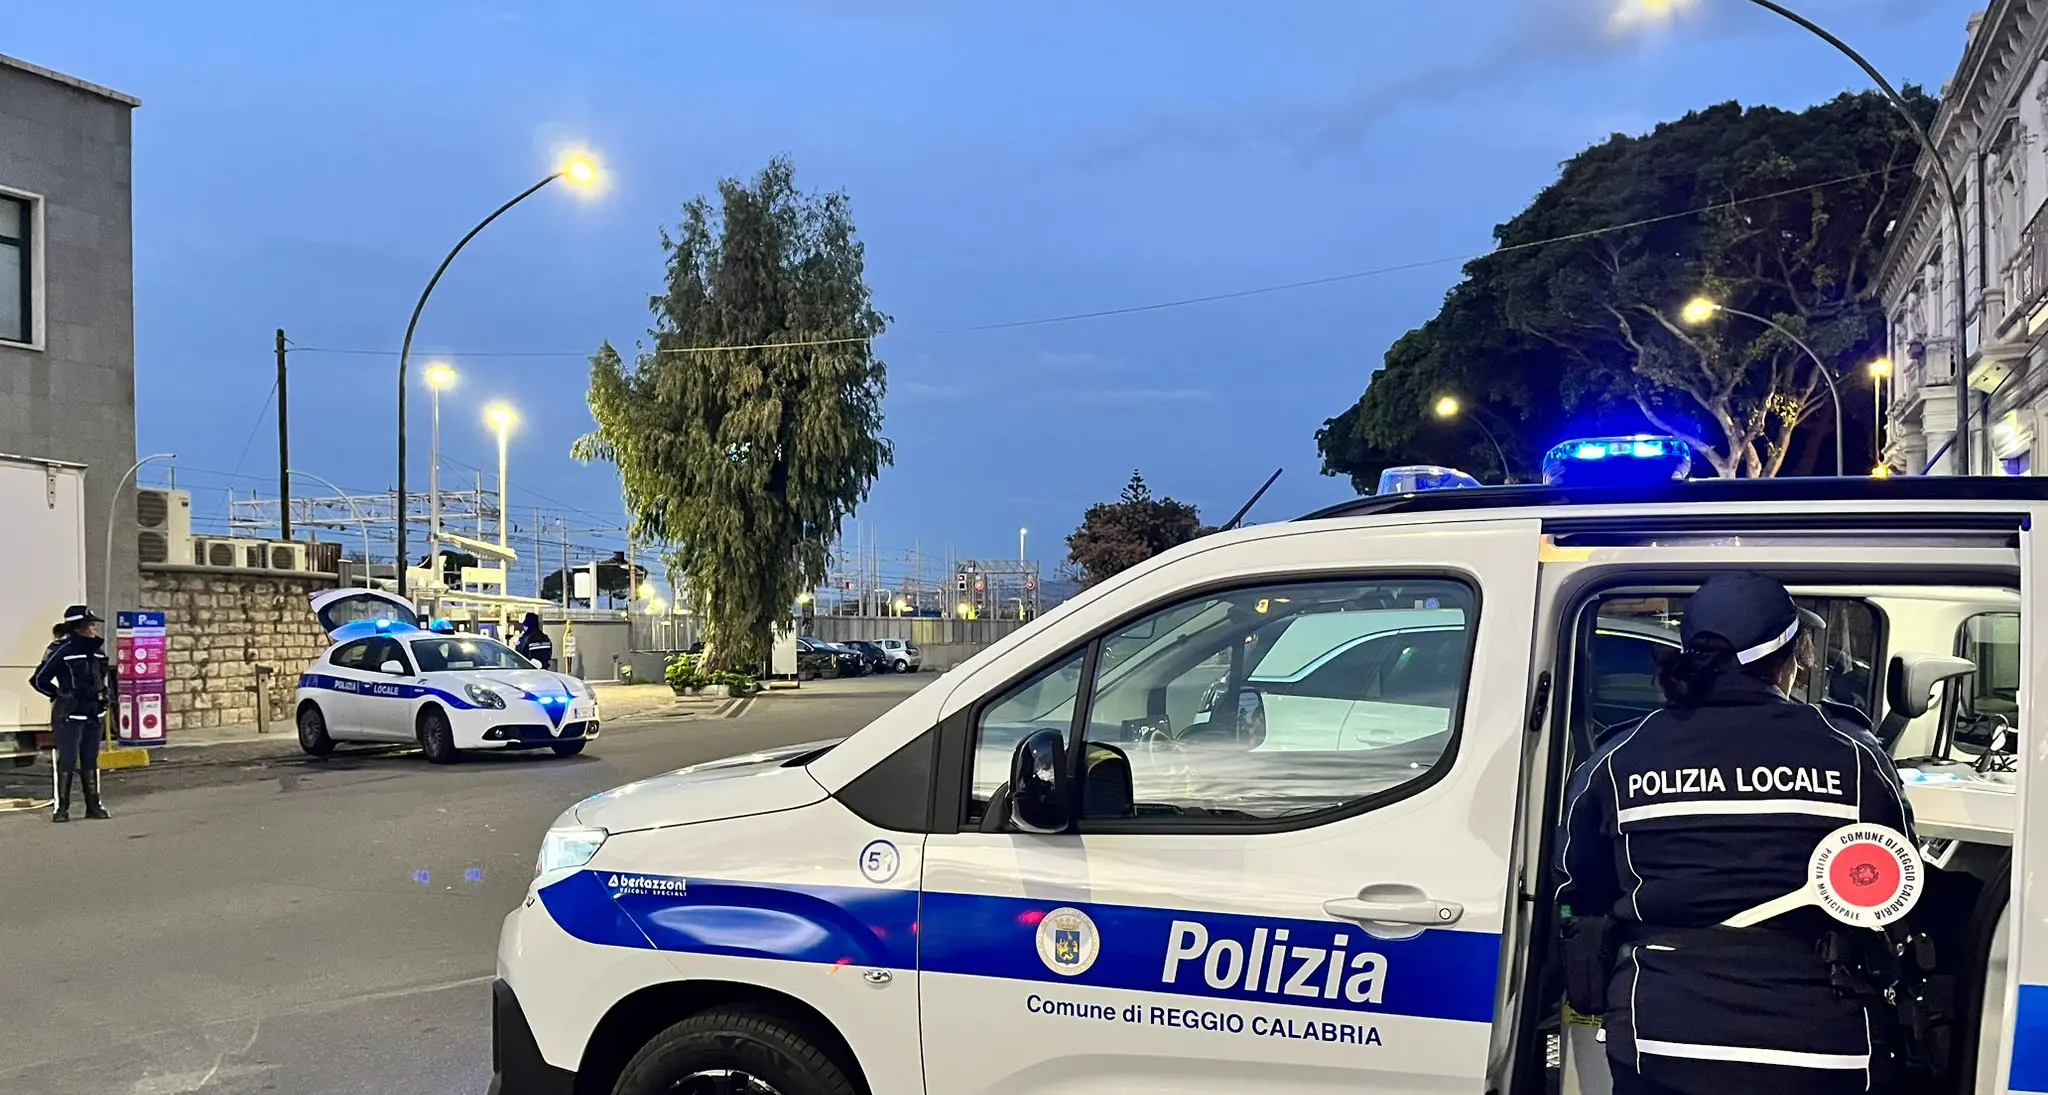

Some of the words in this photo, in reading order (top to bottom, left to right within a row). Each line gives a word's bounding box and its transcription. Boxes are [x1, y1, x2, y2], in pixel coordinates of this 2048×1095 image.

[334, 680, 356, 691] POLIZIA
[373, 684, 399, 695] LOCALE
[1628, 767, 1726, 798] POLIZIA
[1736, 766, 1843, 795] LOCALE
[1840, 831, 1885, 845] COMUNE
[1884, 839, 1898, 850] DI
[1815, 847, 1832, 880] POLIZIA
[1894, 847, 1916, 882] REGGIO
[620, 874, 687, 891] bertazzoni
[653, 889, 687, 897] SPECIALI
[1817, 882, 1861, 921] MUNICIPALE
[1874, 884, 1914, 920] CALABRIA
[1161, 920, 1388, 1004] Polizia
[1026, 994, 1116, 1021] Comune
[1122, 1004, 1142, 1024] di
[1150, 1006, 1244, 1034] REGGIO
[1251, 1016, 1383, 1046] CALABRIA
